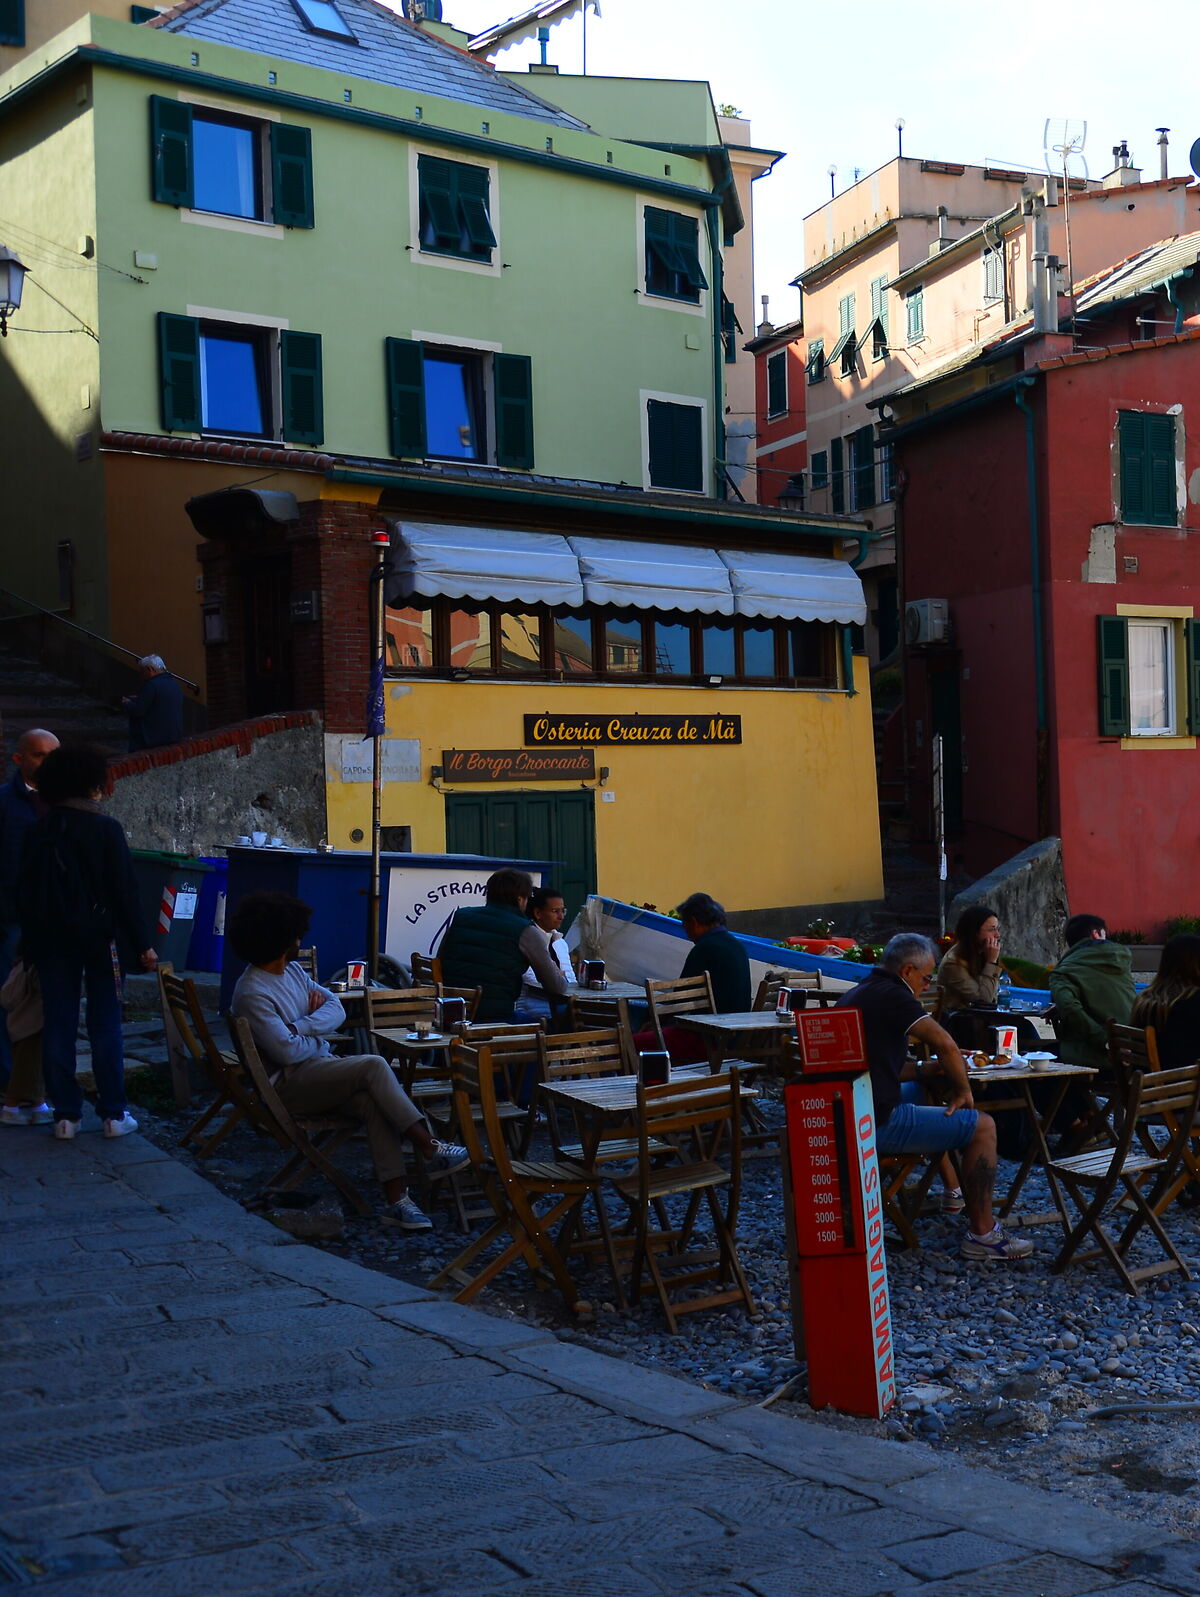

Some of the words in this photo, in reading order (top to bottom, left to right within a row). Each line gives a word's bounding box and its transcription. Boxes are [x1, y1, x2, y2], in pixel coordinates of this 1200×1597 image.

[533, 718, 602, 741] Osteria
[606, 719, 673, 741] Creuza
[677, 719, 697, 740] de
[702, 719, 736, 740] Mä
[448, 753, 464, 770] Il
[467, 752, 513, 778] Borgo
[515, 752, 591, 770] Croccante
[405, 902, 427, 925] LA
[427, 882, 488, 904] STRAM
[800, 1098, 825, 1110] 12000
[802, 1116, 827, 1128] 10500
[808, 1135, 828, 1147] 9000
[809, 1154, 830, 1166] 7500
[811, 1174, 832, 1185] 6000
[813, 1193, 833, 1204] 4500
[815, 1212, 835, 1223] 3000
[816, 1231, 837, 1242] 1500
[859, 1113, 894, 1412] CAMBIAGESTO
